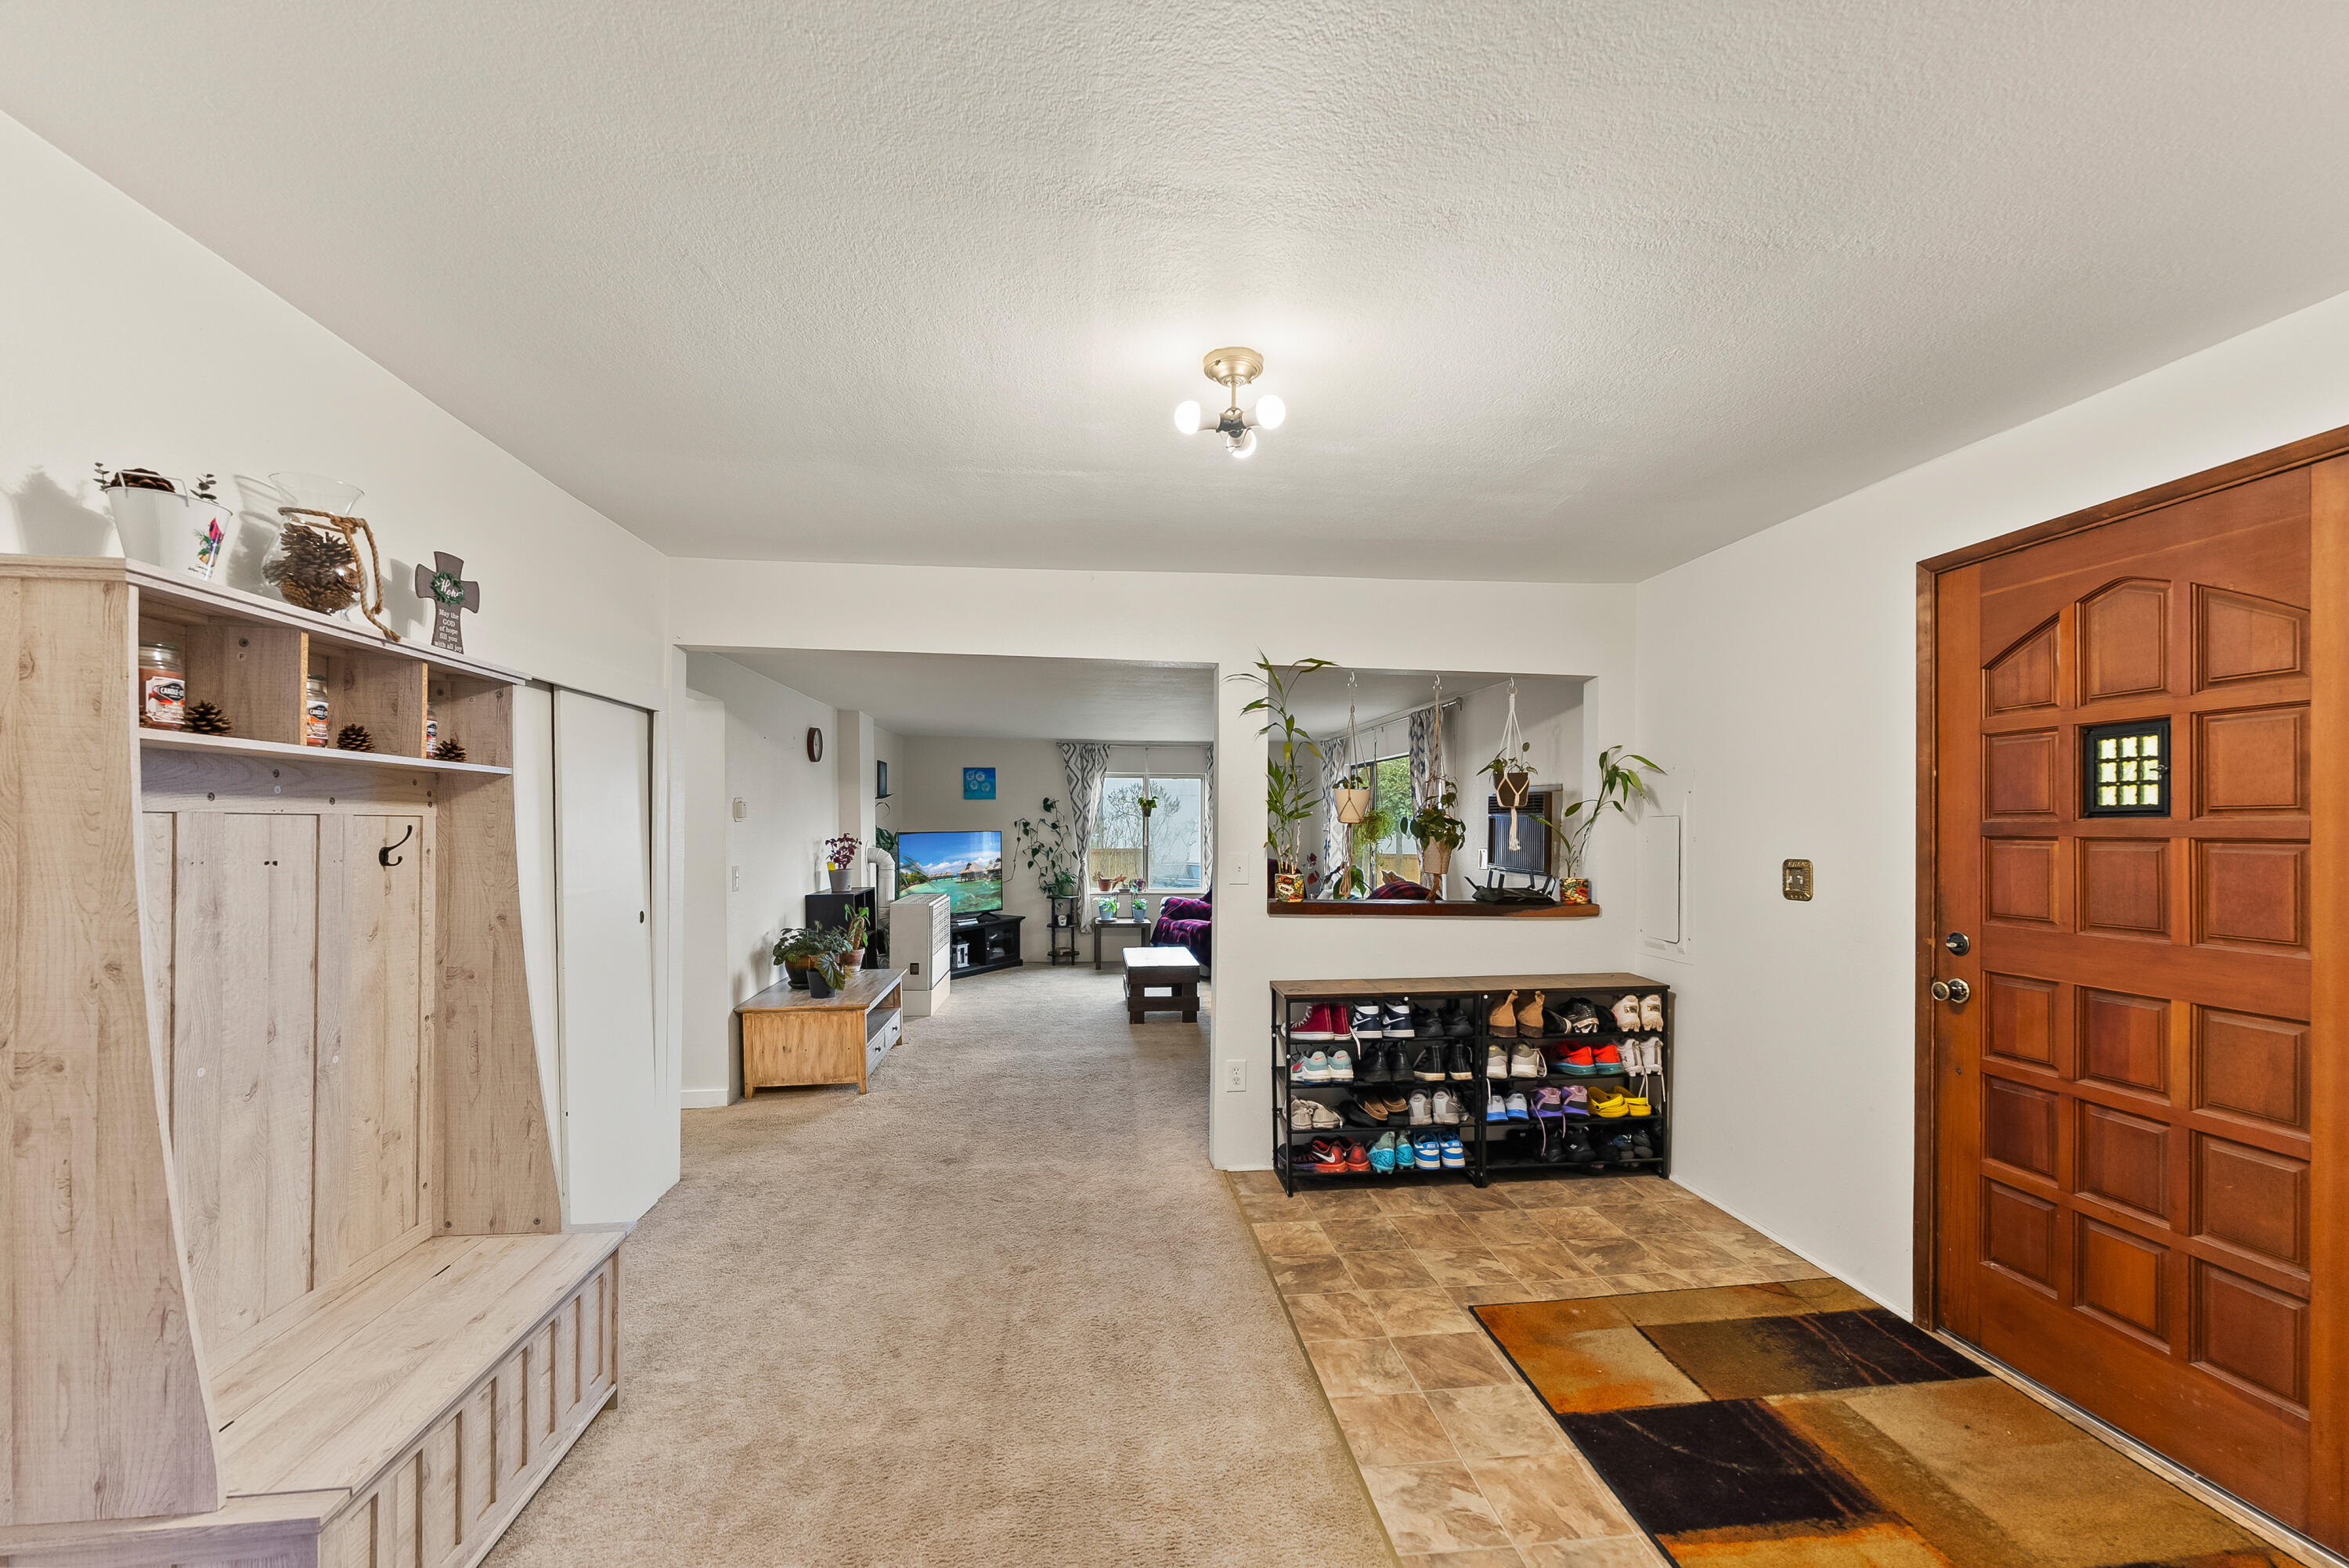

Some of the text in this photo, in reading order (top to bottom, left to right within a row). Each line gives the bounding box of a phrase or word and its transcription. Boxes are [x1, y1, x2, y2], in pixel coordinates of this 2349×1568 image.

[438, 608, 449, 618] May
[442, 618, 455, 627] GOD
[446, 626, 458, 635] hope
[454, 644, 463, 653] joy
